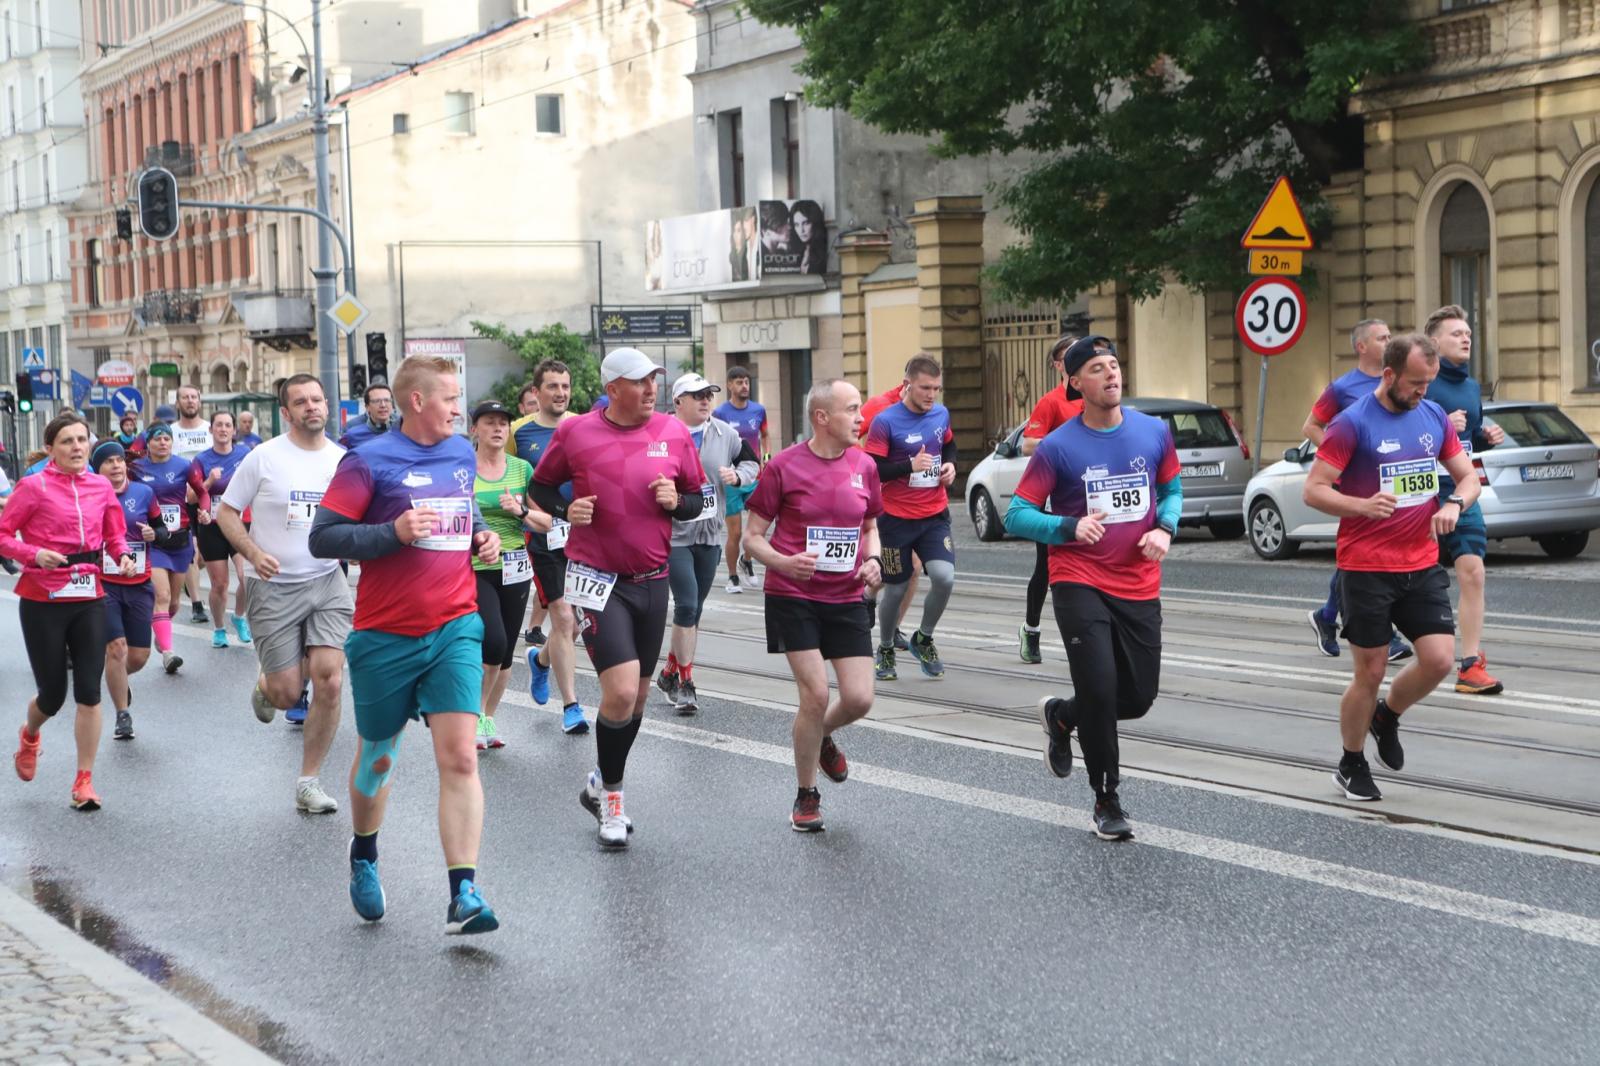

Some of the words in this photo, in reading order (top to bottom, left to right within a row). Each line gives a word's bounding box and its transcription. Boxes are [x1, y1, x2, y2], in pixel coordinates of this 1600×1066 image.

[1261, 255, 1279, 269] 30
[1281, 261, 1290, 270] m
[1247, 295, 1297, 334] 30
[409, 343, 460, 353] POLIGRAFIA
[1092, 481, 1105, 492] 19.
[1401, 474, 1434, 493] 1538
[1112, 489, 1141, 508] 593
[813, 529, 825, 539] 19.
[825, 542, 856, 558] 2579
[575, 576, 607, 597] 1178
